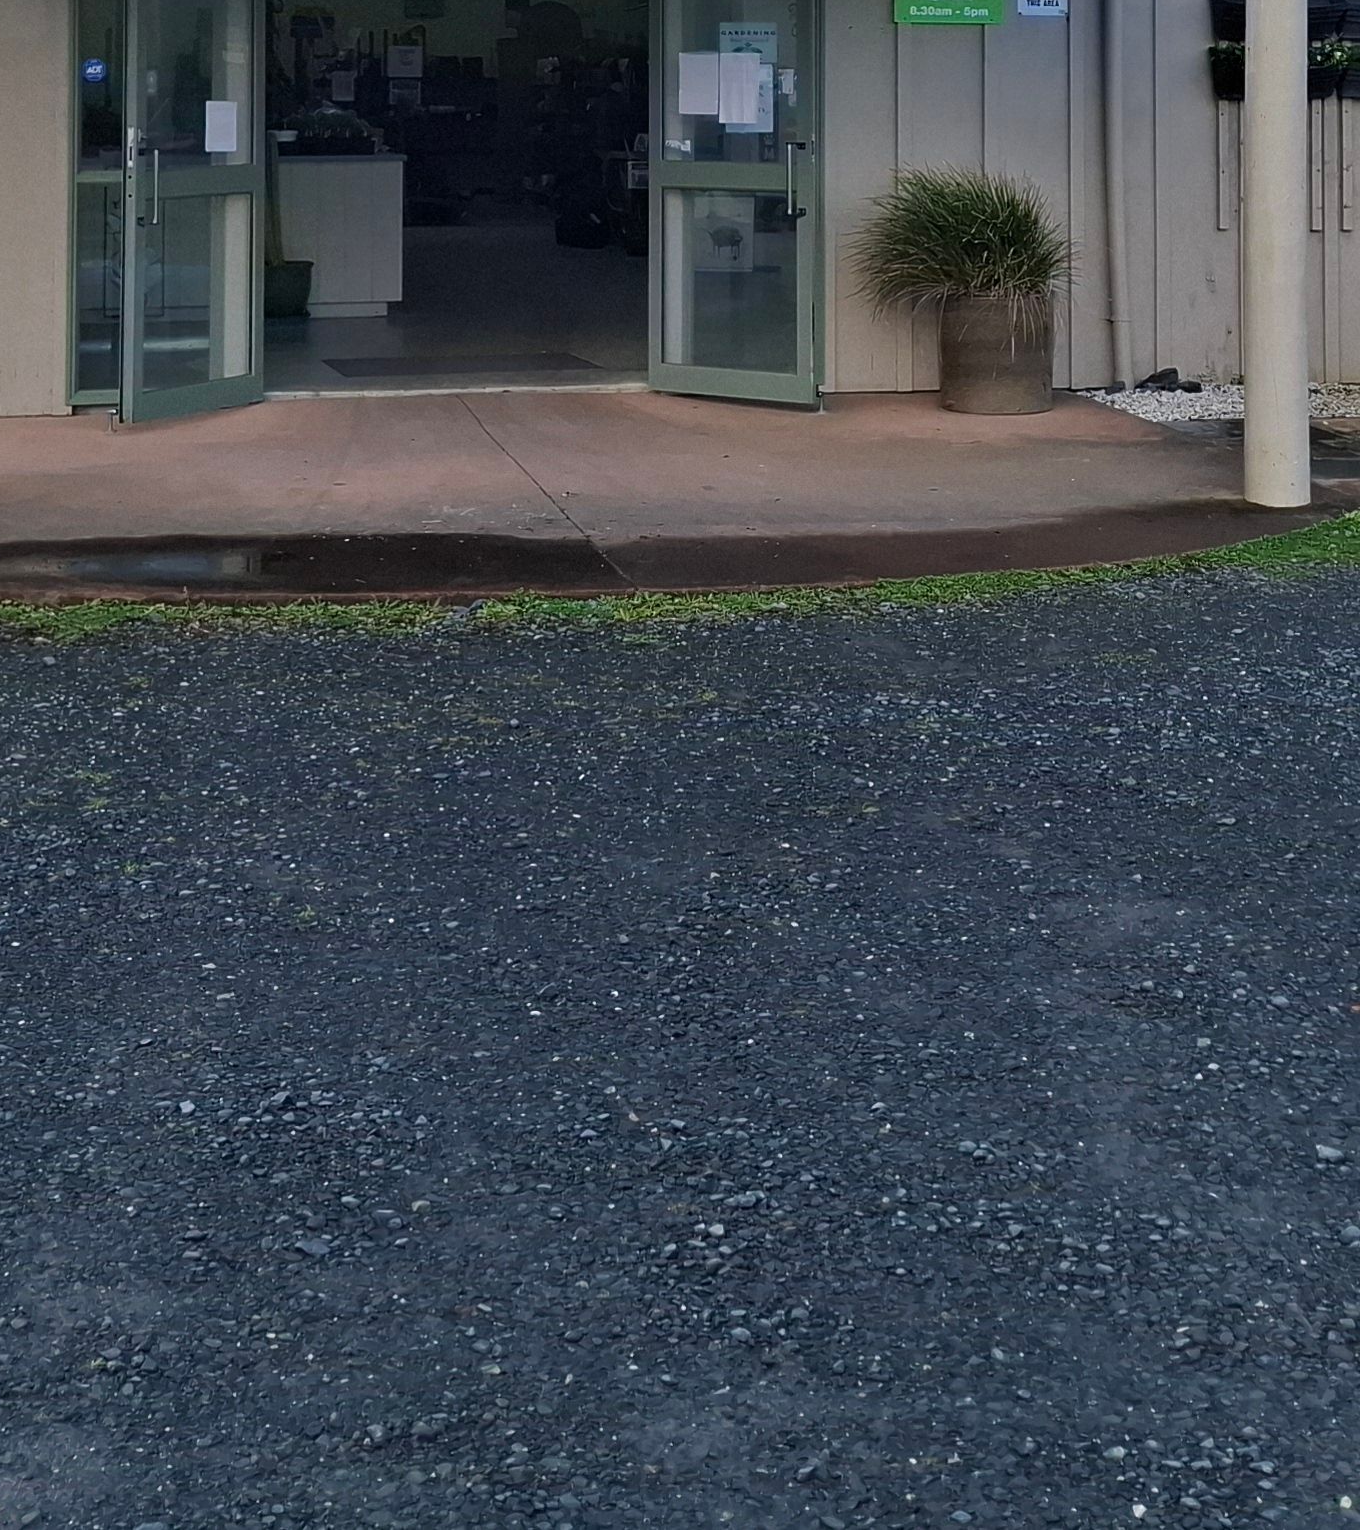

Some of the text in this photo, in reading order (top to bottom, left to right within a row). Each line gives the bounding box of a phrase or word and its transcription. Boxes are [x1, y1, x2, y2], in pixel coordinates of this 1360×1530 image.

[1026, 0, 1060, 7] THIS AREA
[909, 6, 953, 16] 8.30am
[963, 6, 989, 18] 5pm
